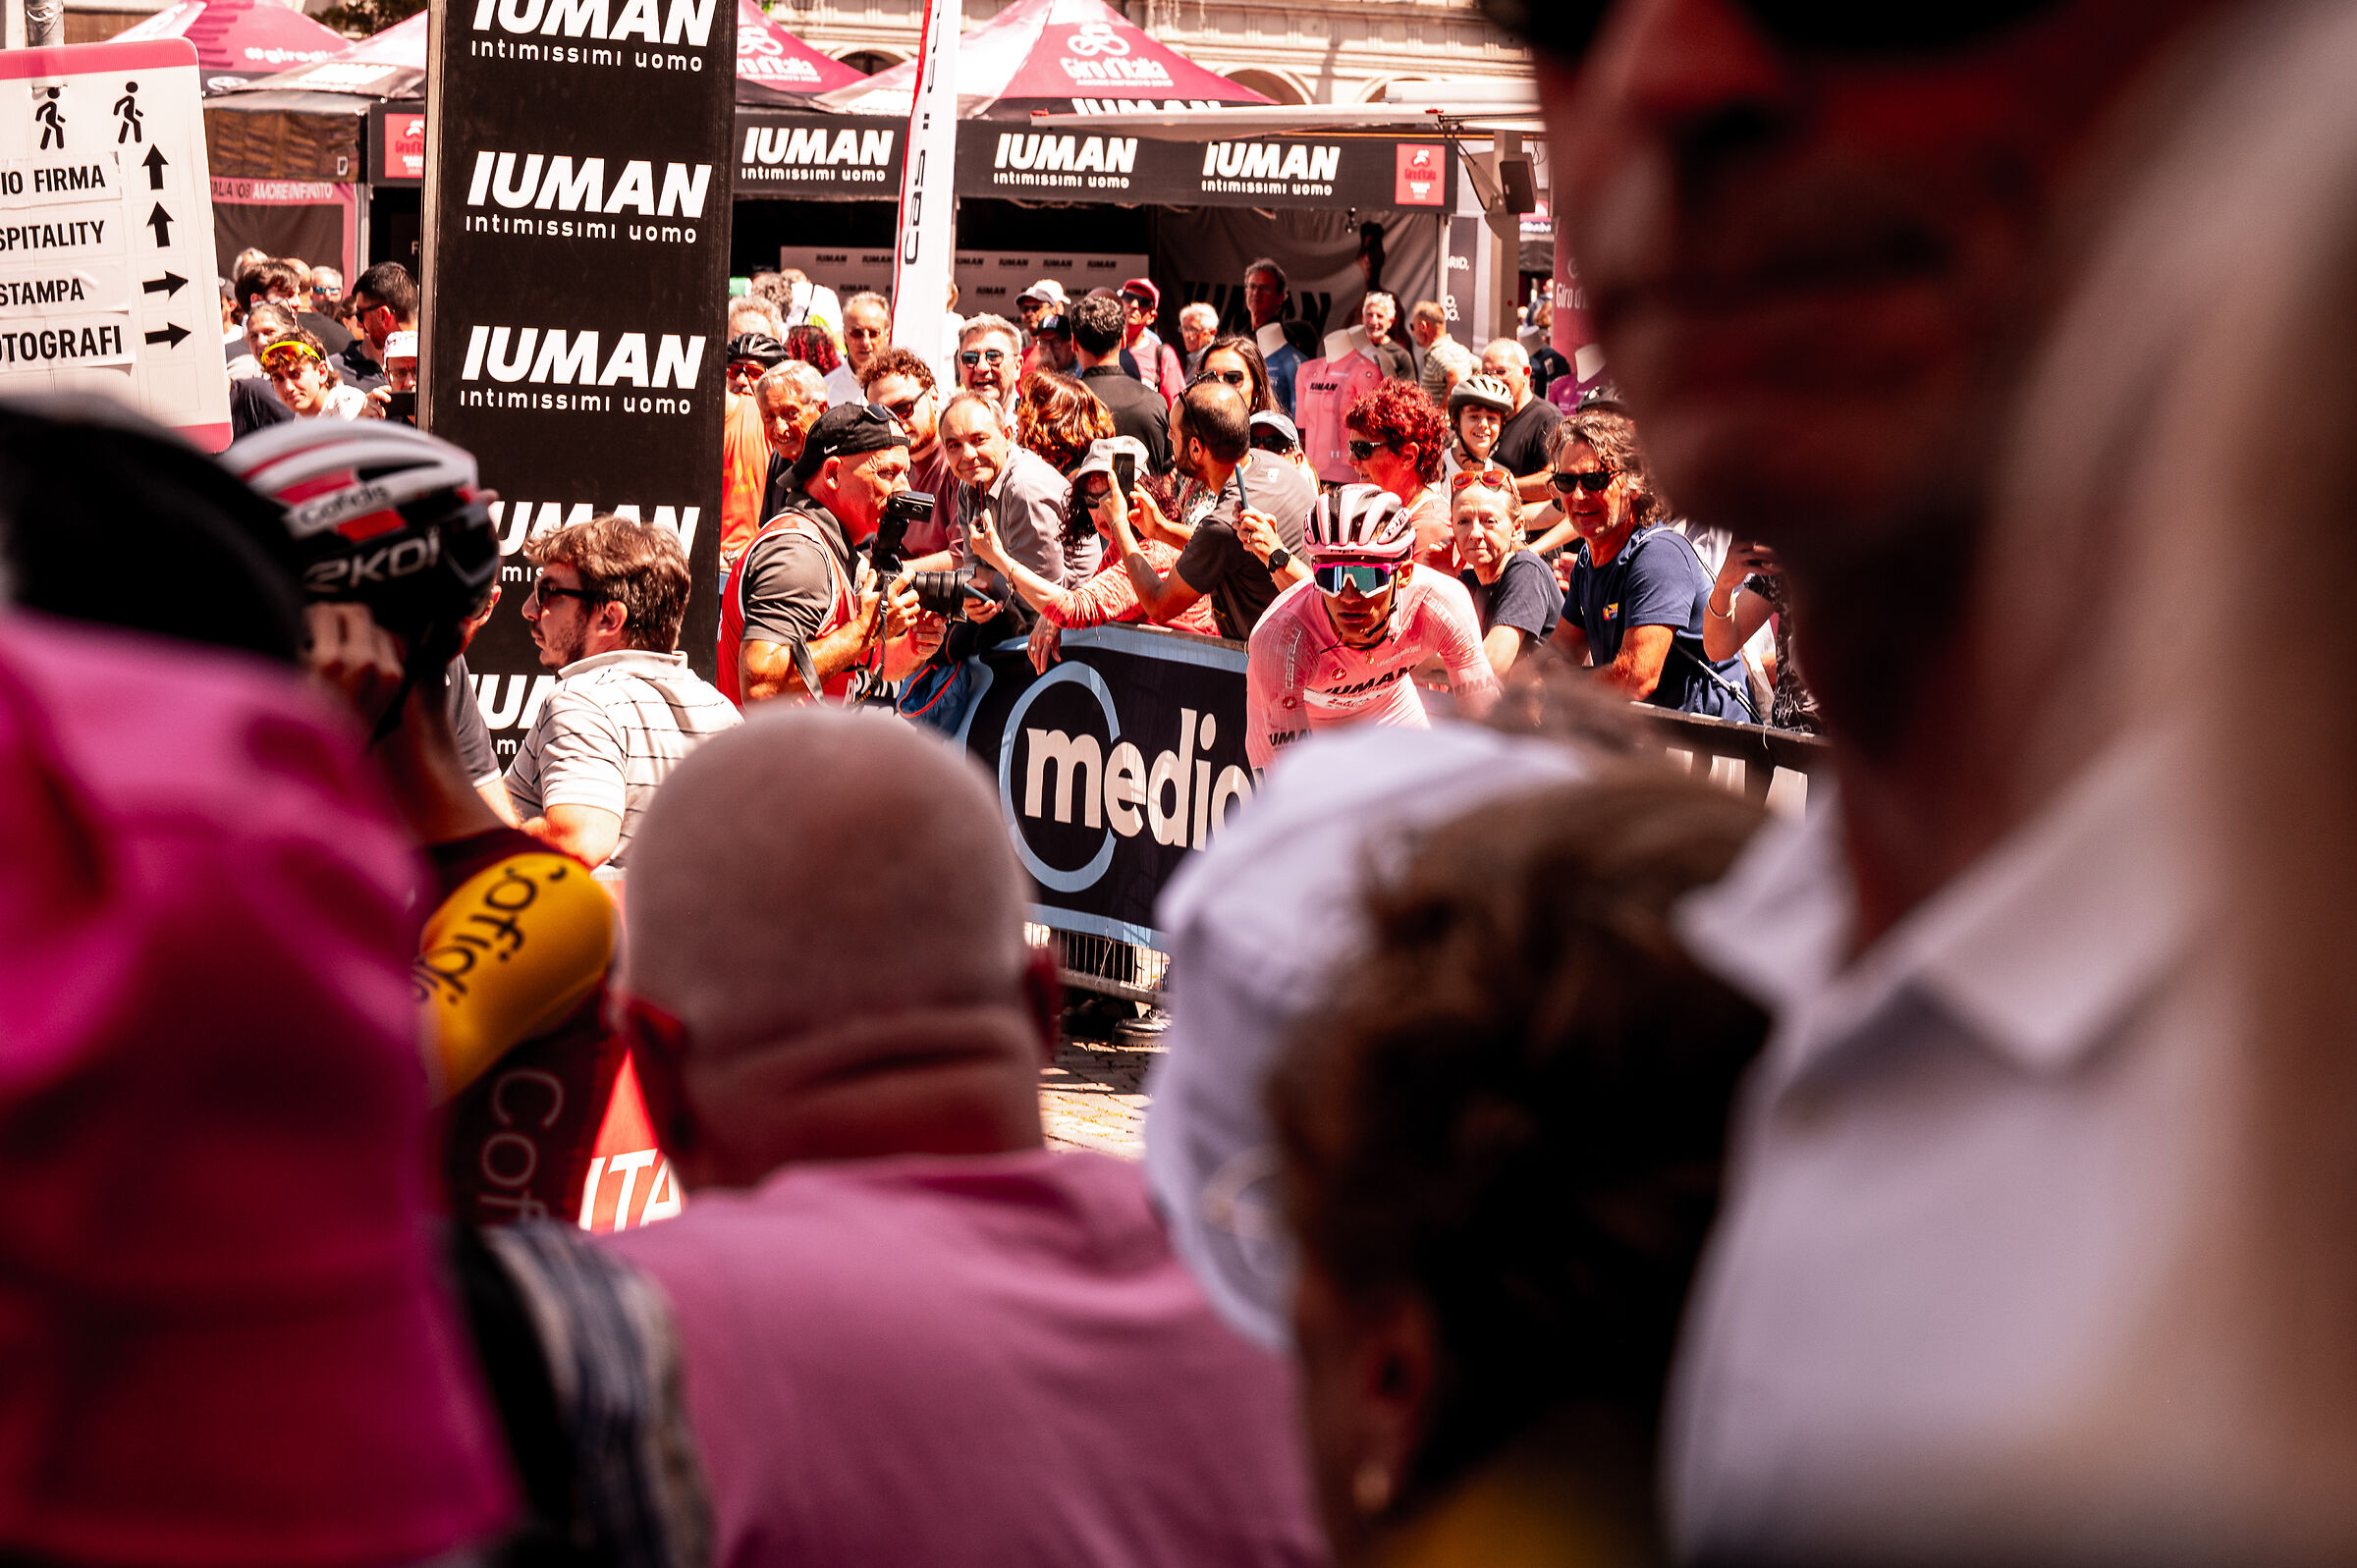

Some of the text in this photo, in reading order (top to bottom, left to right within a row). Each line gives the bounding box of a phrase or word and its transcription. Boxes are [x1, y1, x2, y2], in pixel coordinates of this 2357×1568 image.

[470, 39, 703, 72] intimissimi uomo
[741, 127, 895, 166] IUMAN
[994, 133, 1138, 174] IUMAN
[1202, 141, 1342, 181] IUMAN
[33, 165, 107, 192] FIRMA
[466, 150, 713, 218] IUMAN
[740, 167, 886, 183] intimissimi uomo
[993, 172, 1129, 189] intimissimi uomo
[1201, 180, 1333, 196] intimissimi uomo
[211, 181, 233, 197] ALIA
[466, 215, 697, 243] intimissimi uomo
[816, 254, 848, 263] IUMAN
[999, 258, 1029, 267] IUMAN
[1043, 259, 1073, 268] IUMAN
[1087, 260, 1117, 269] IUMAN
[0, 278, 84, 306] STAMPA
[1556, 283, 1573, 309] Giro
[0, 325, 123, 362] TOGRAFI
[462, 325, 707, 390] IUMAN
[460, 390, 691, 415] intimissimi uomo
